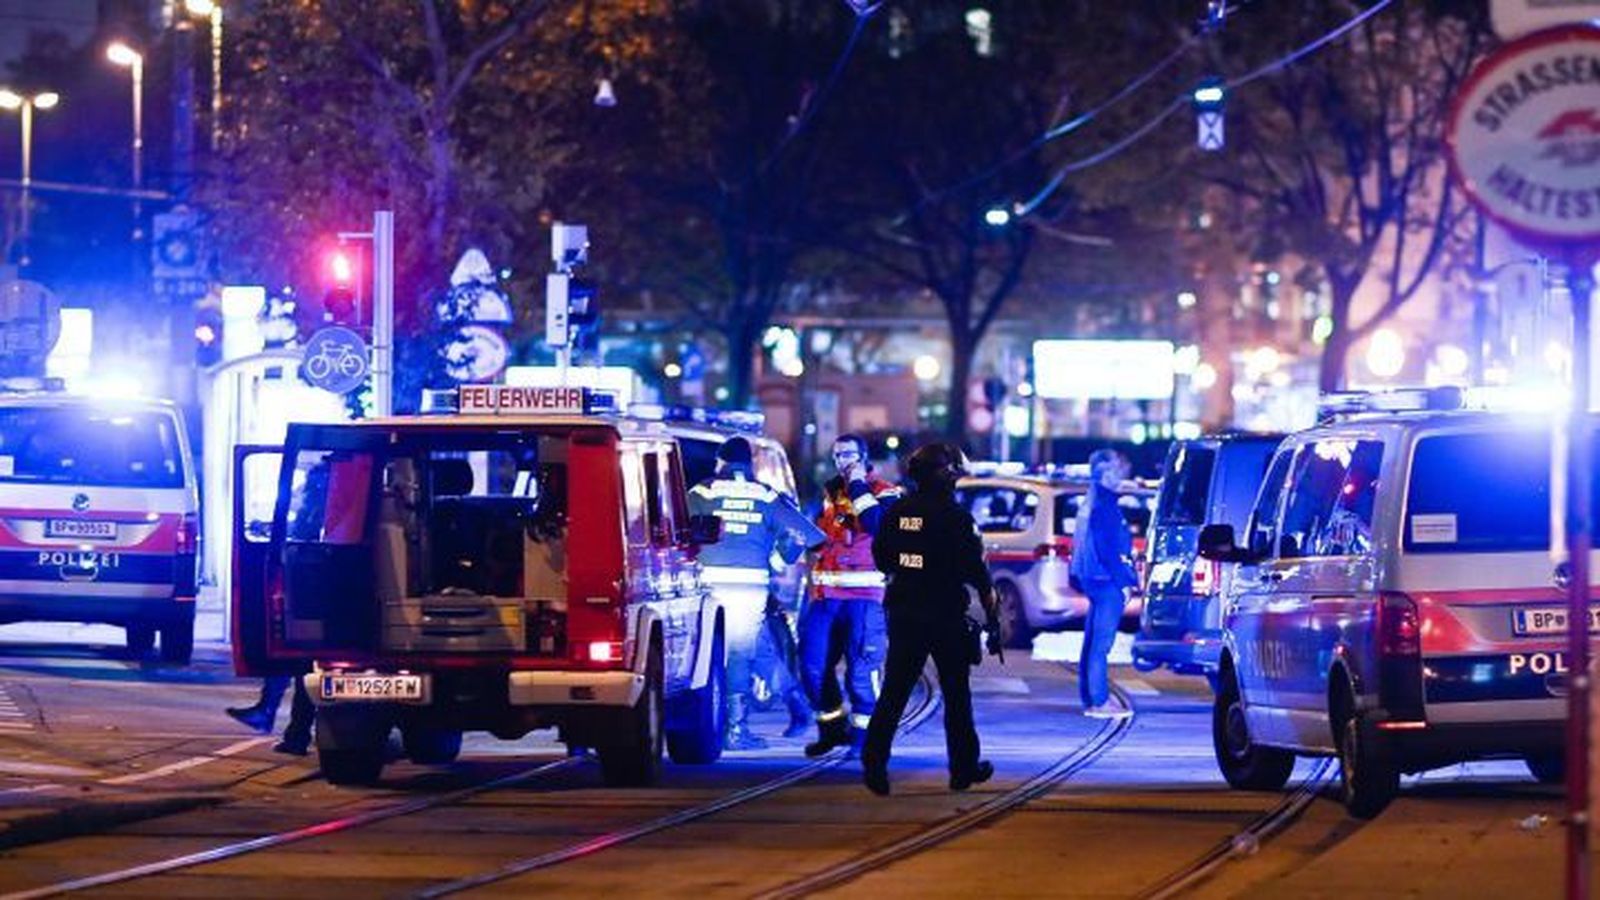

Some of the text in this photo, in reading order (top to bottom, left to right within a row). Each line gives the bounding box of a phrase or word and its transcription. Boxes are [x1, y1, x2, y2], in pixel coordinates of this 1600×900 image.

[462, 388, 581, 408] FEUERWEHR
[38, 552, 119, 568] POLIZEI
[1533, 613, 1554, 627] BP
[1510, 653, 1570, 674] POL
